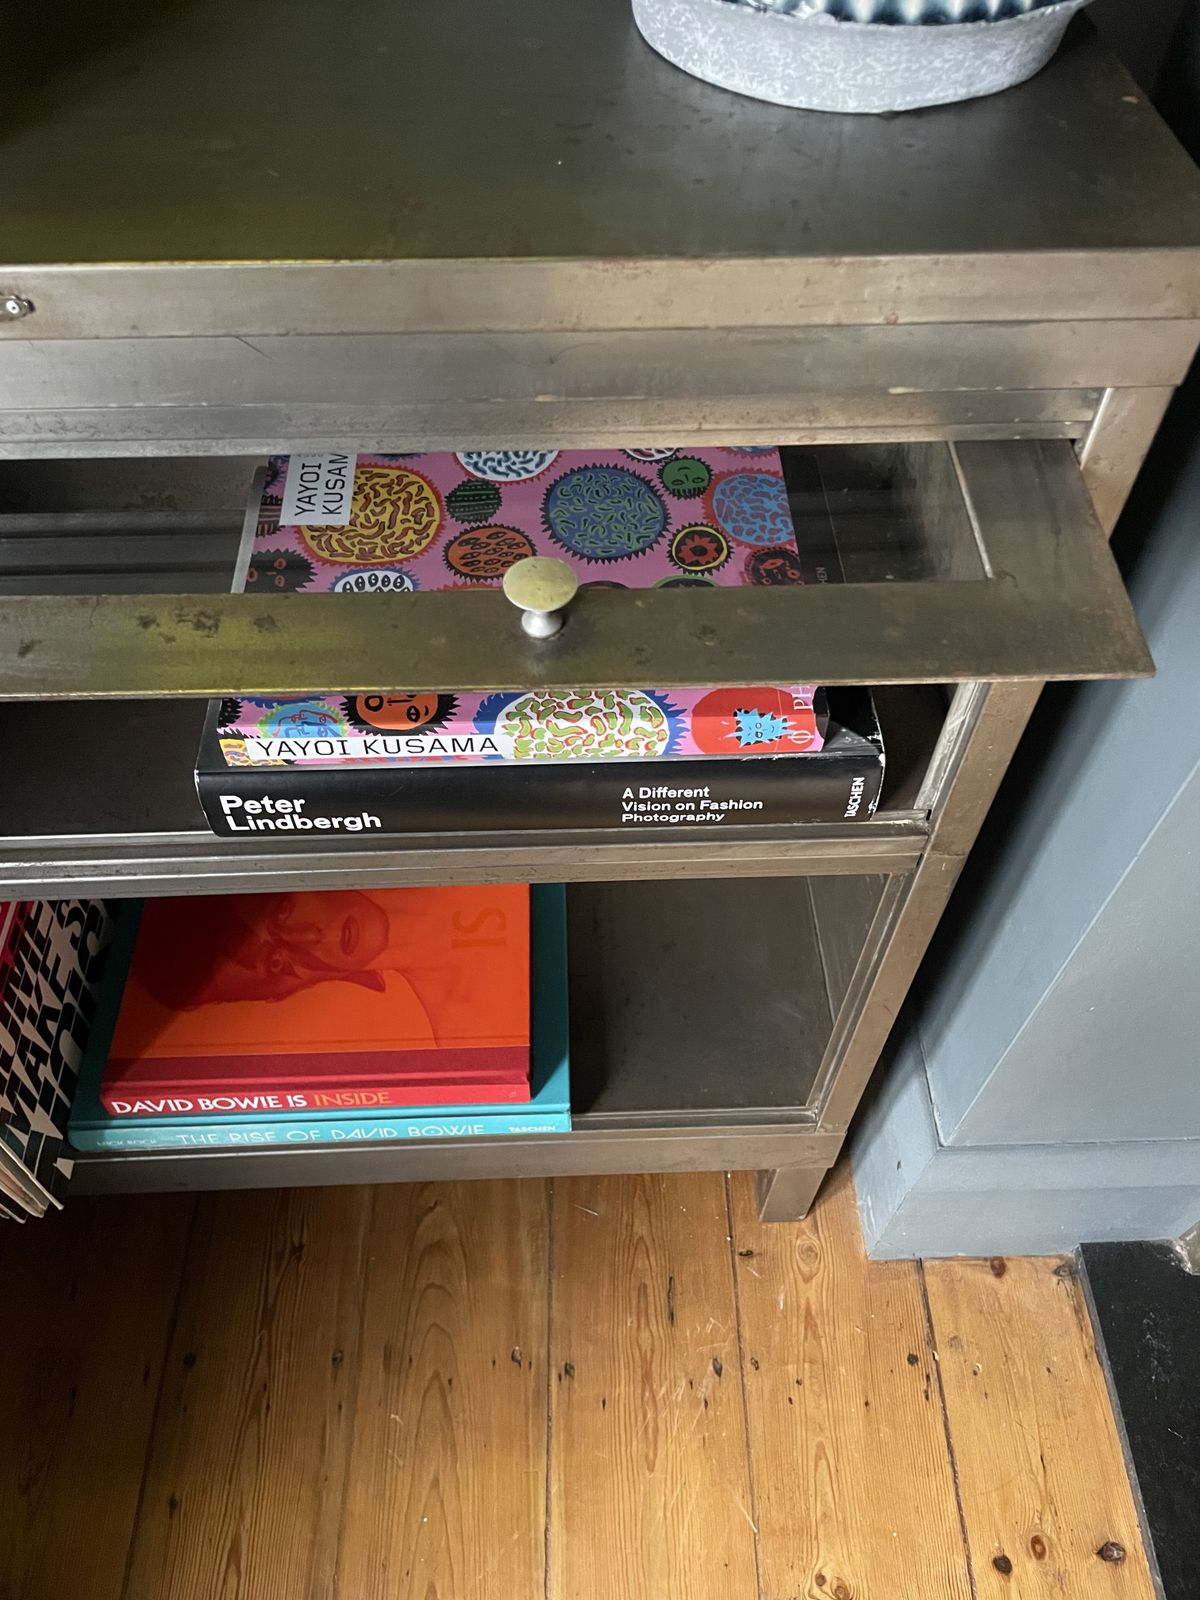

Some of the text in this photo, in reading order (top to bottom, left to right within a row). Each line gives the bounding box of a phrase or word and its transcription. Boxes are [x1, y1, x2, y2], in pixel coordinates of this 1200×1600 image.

[294, 463, 322, 516] YAYOI
[321, 453, 349, 515] KUSAM
[255, 737, 499, 757] YAYOI KUSAMA
[622, 786, 710, 799] A Different
[844, 777, 865, 818] TASCHEN
[219, 795, 305, 815] Peter
[622, 800, 763, 812] Vision on Fashion
[225, 812, 382, 831] Lindbergh
[622, 812, 725, 823] Photography
[451, 906, 507, 949] IS
[112, 1092, 392, 1114] DAVID BOWIE IS INSIDE
[176, 1133, 220, 1145] THE
[229, 1131, 276, 1144] RISE
[286, 1128, 323, 1141] OF
[332, 1126, 397, 1141] DAVID
[407, 1124, 486, 1138] BOWIE
